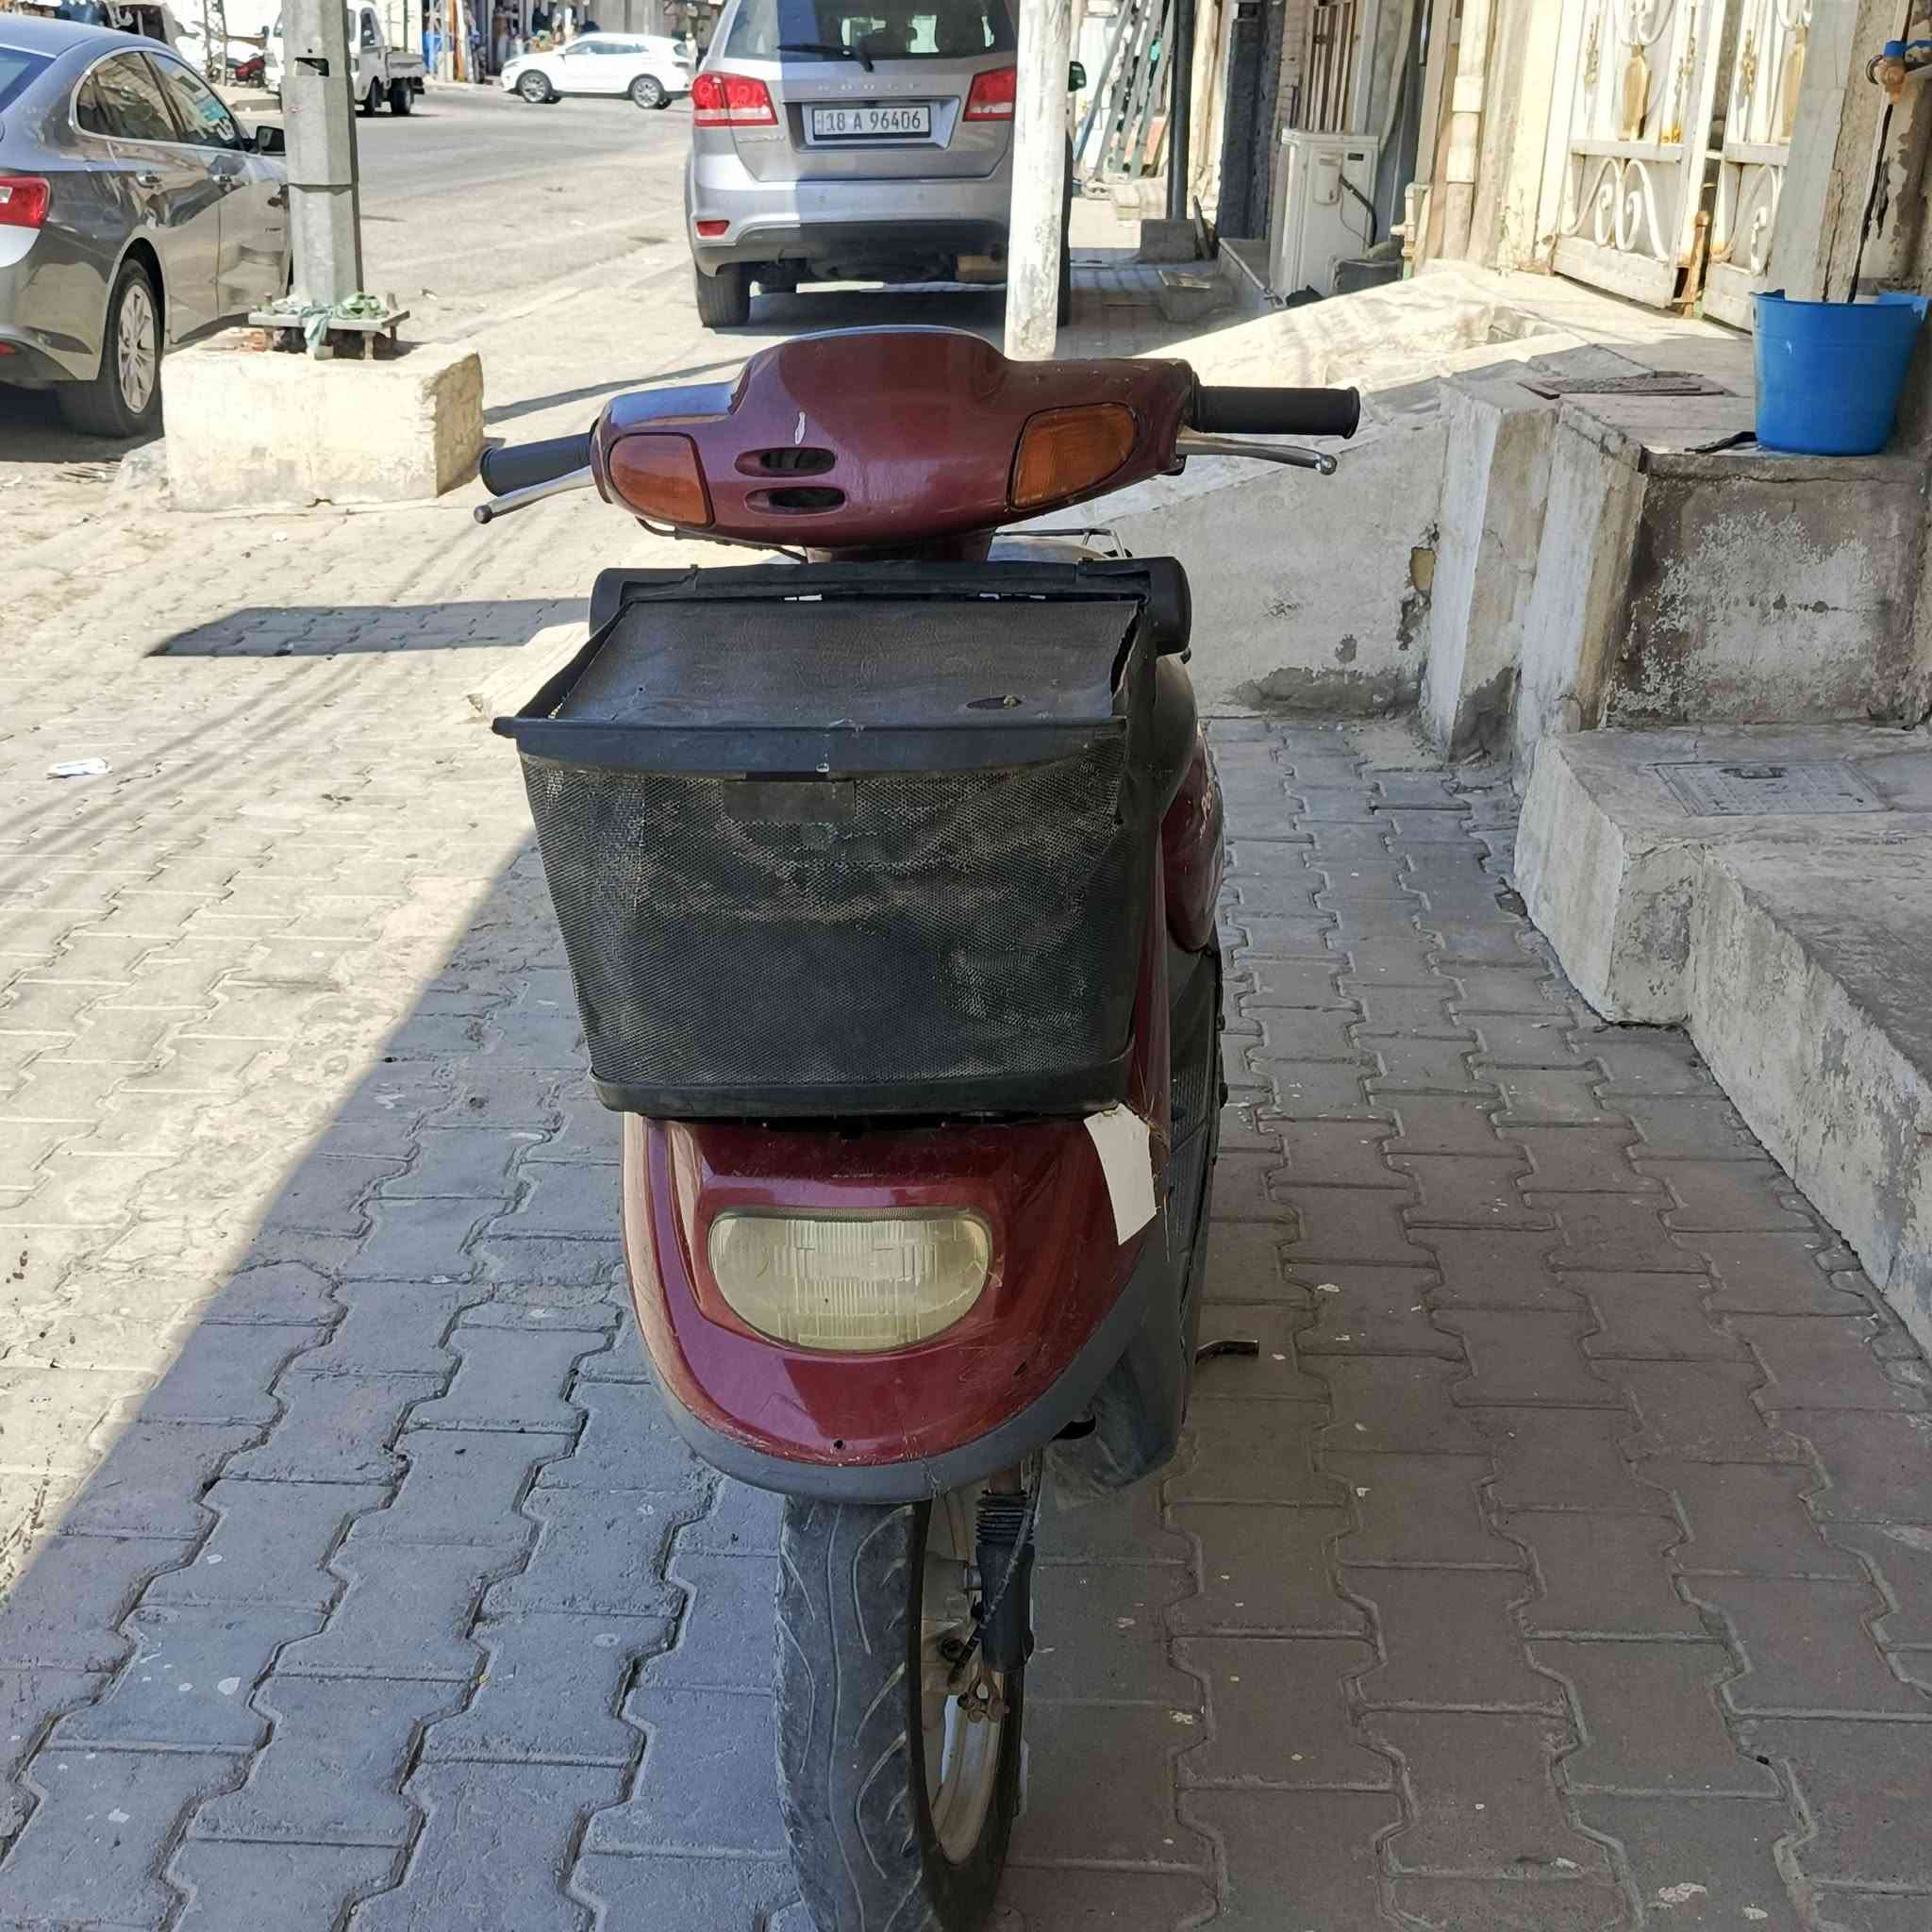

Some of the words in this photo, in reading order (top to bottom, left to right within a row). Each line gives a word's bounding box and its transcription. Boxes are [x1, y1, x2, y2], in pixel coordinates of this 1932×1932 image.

[825, 112, 846, 131] 18
[853, 111, 862, 130] A
[870, 110, 921, 130] 96406
